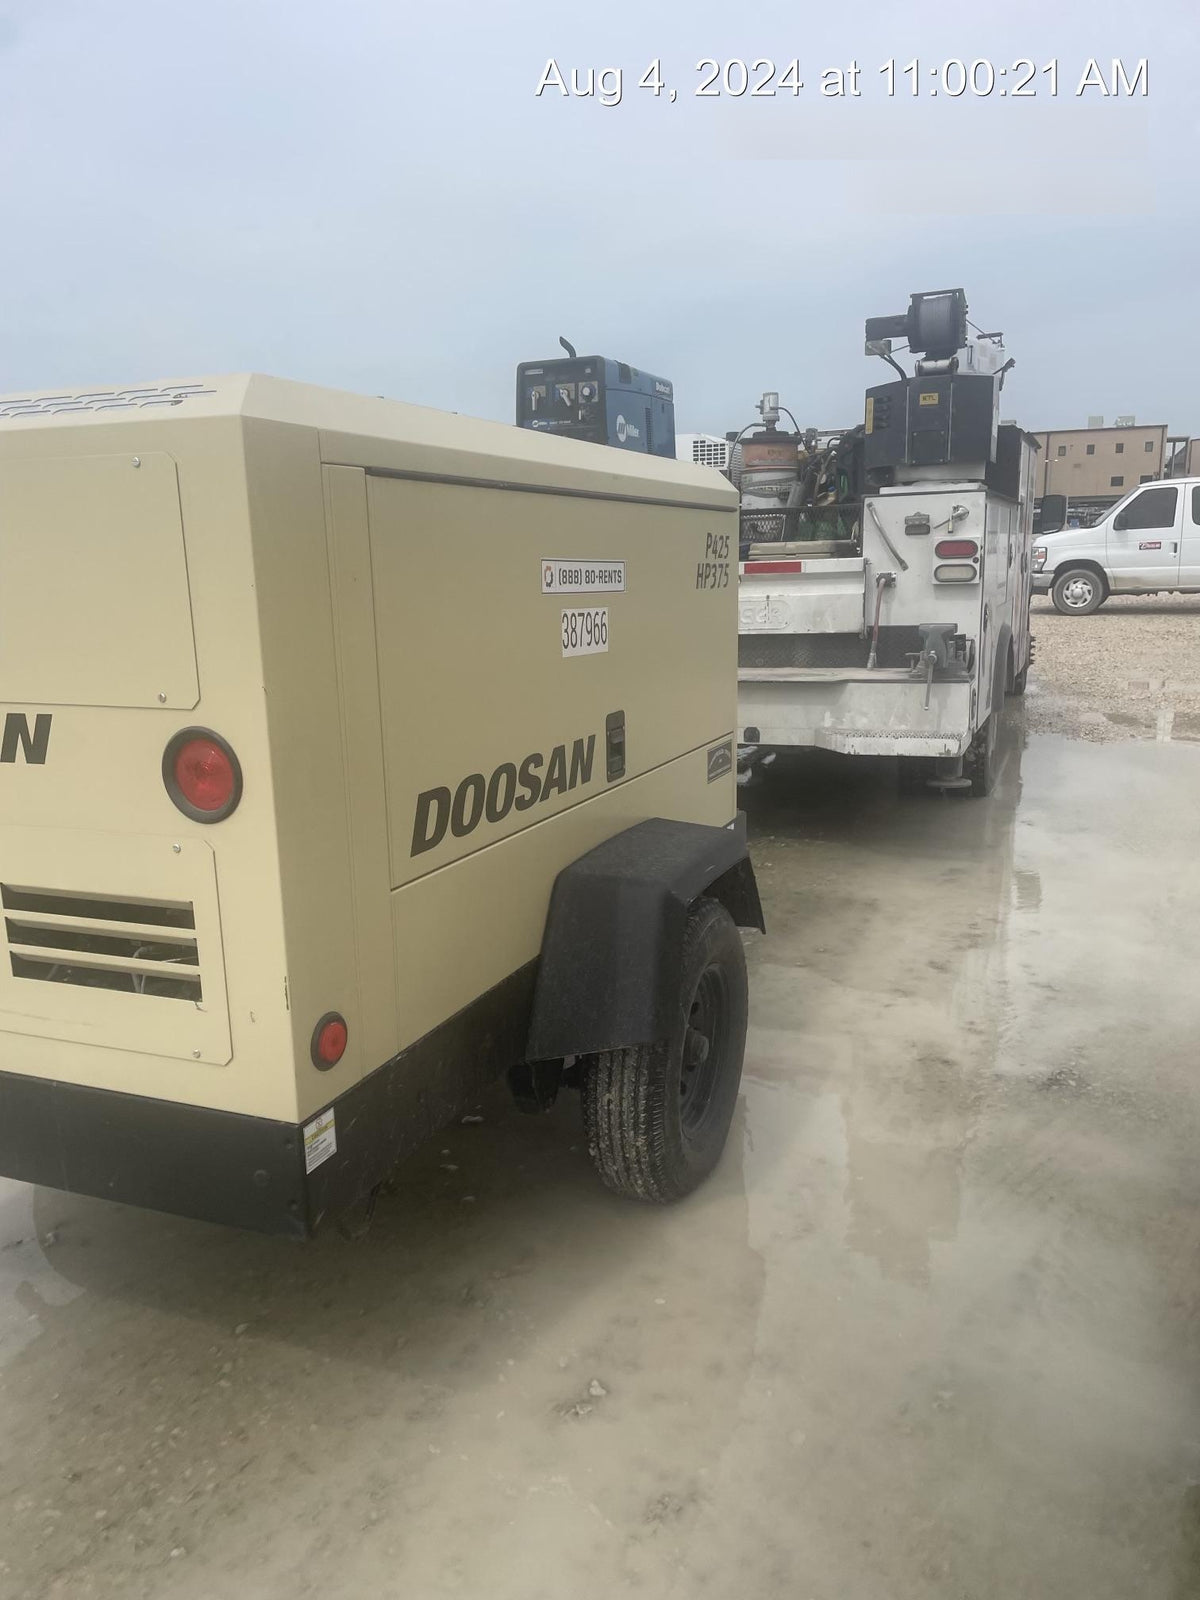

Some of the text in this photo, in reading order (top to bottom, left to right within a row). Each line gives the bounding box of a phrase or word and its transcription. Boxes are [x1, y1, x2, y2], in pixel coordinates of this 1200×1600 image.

[705, 532, 730, 560] P425
[558, 567, 622, 586] (888) 80-RENTS
[696, 562, 730, 590] HP375
[561, 611, 608, 650] 387966
[0, 712, 53, 765] N
[410, 733, 596, 858] DOOSAN
